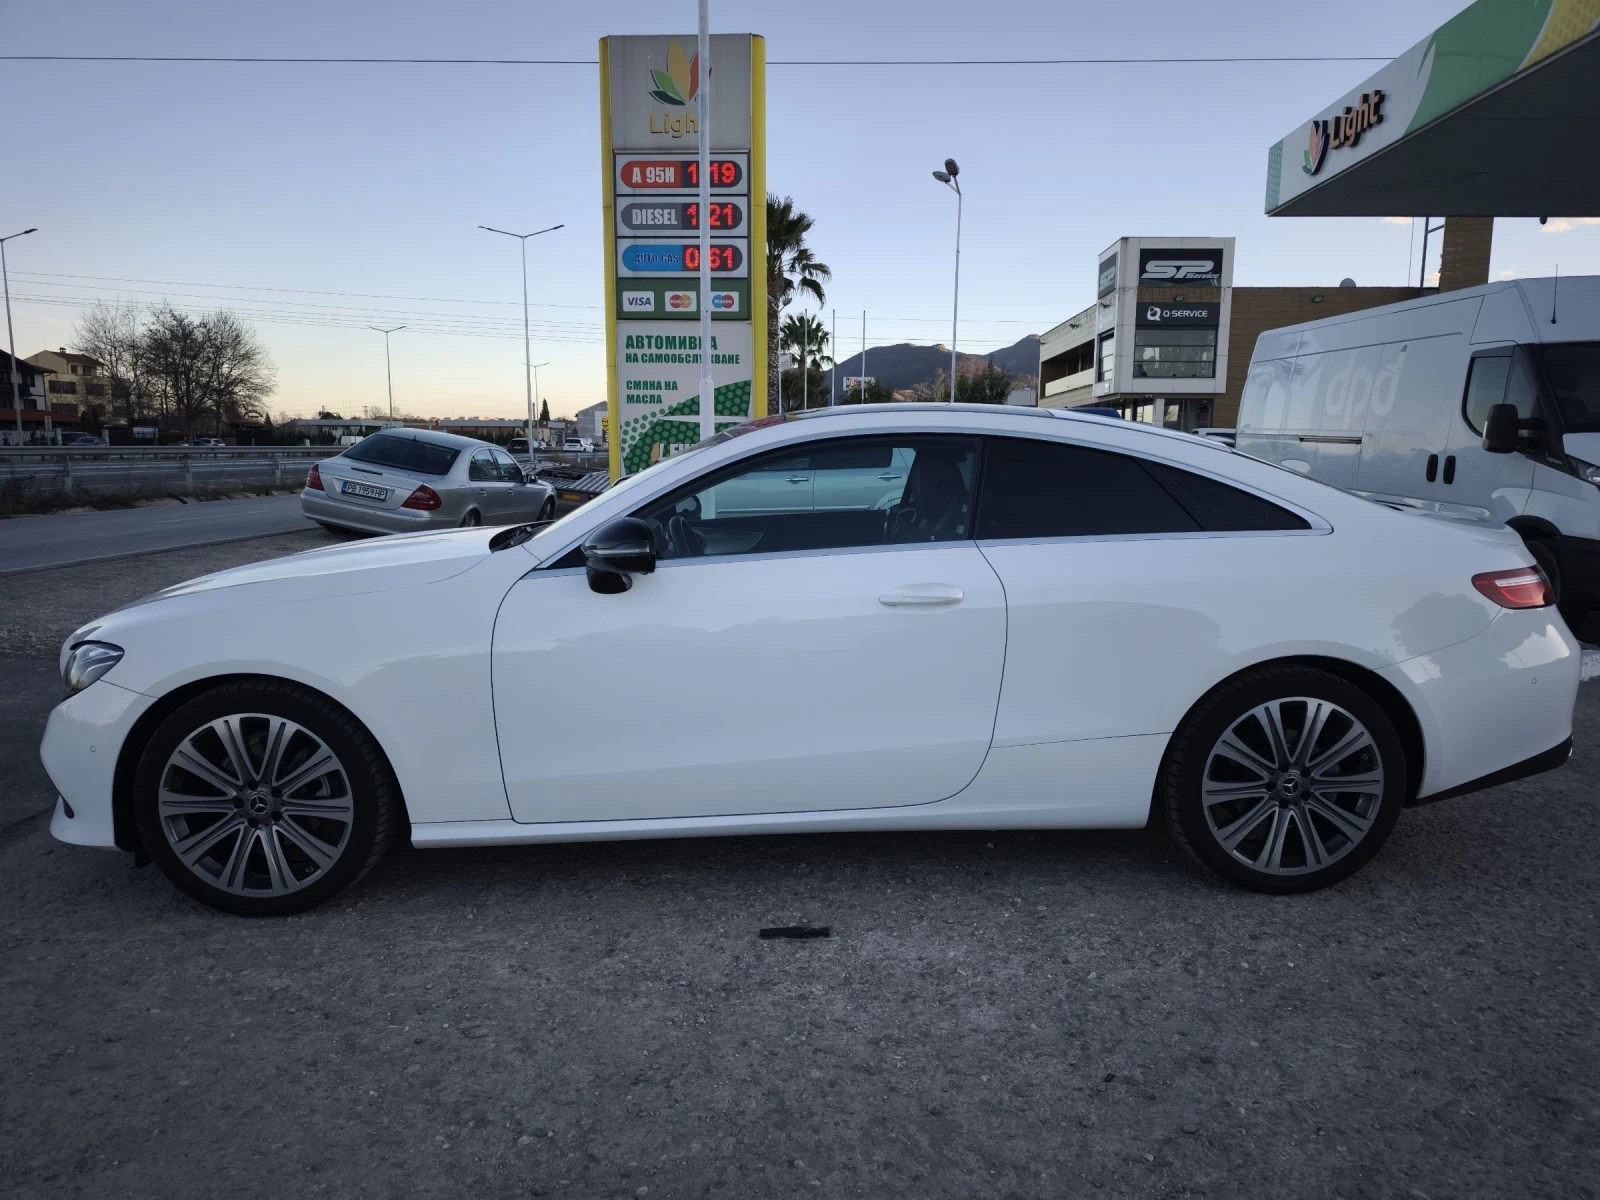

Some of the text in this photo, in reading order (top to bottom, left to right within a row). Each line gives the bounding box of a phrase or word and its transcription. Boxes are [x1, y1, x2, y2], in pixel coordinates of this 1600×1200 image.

[650, 112, 700, 138] Ligh
[1329, 90, 1386, 149] Light
[632, 209, 678, 225] DIESEL
[634, 253, 679, 263] AUTO GAS
[1141, 260, 1214, 278] SP
[628, 297, 651, 306] VISA
[625, 335, 718, 351] АВТОМИВА
[625, 353, 740, 365] НА САМООБСЛВАНЕ
[626, 380, 678, 391] СМЯНА НА
[626, 394, 663, 404] МАСЛА
